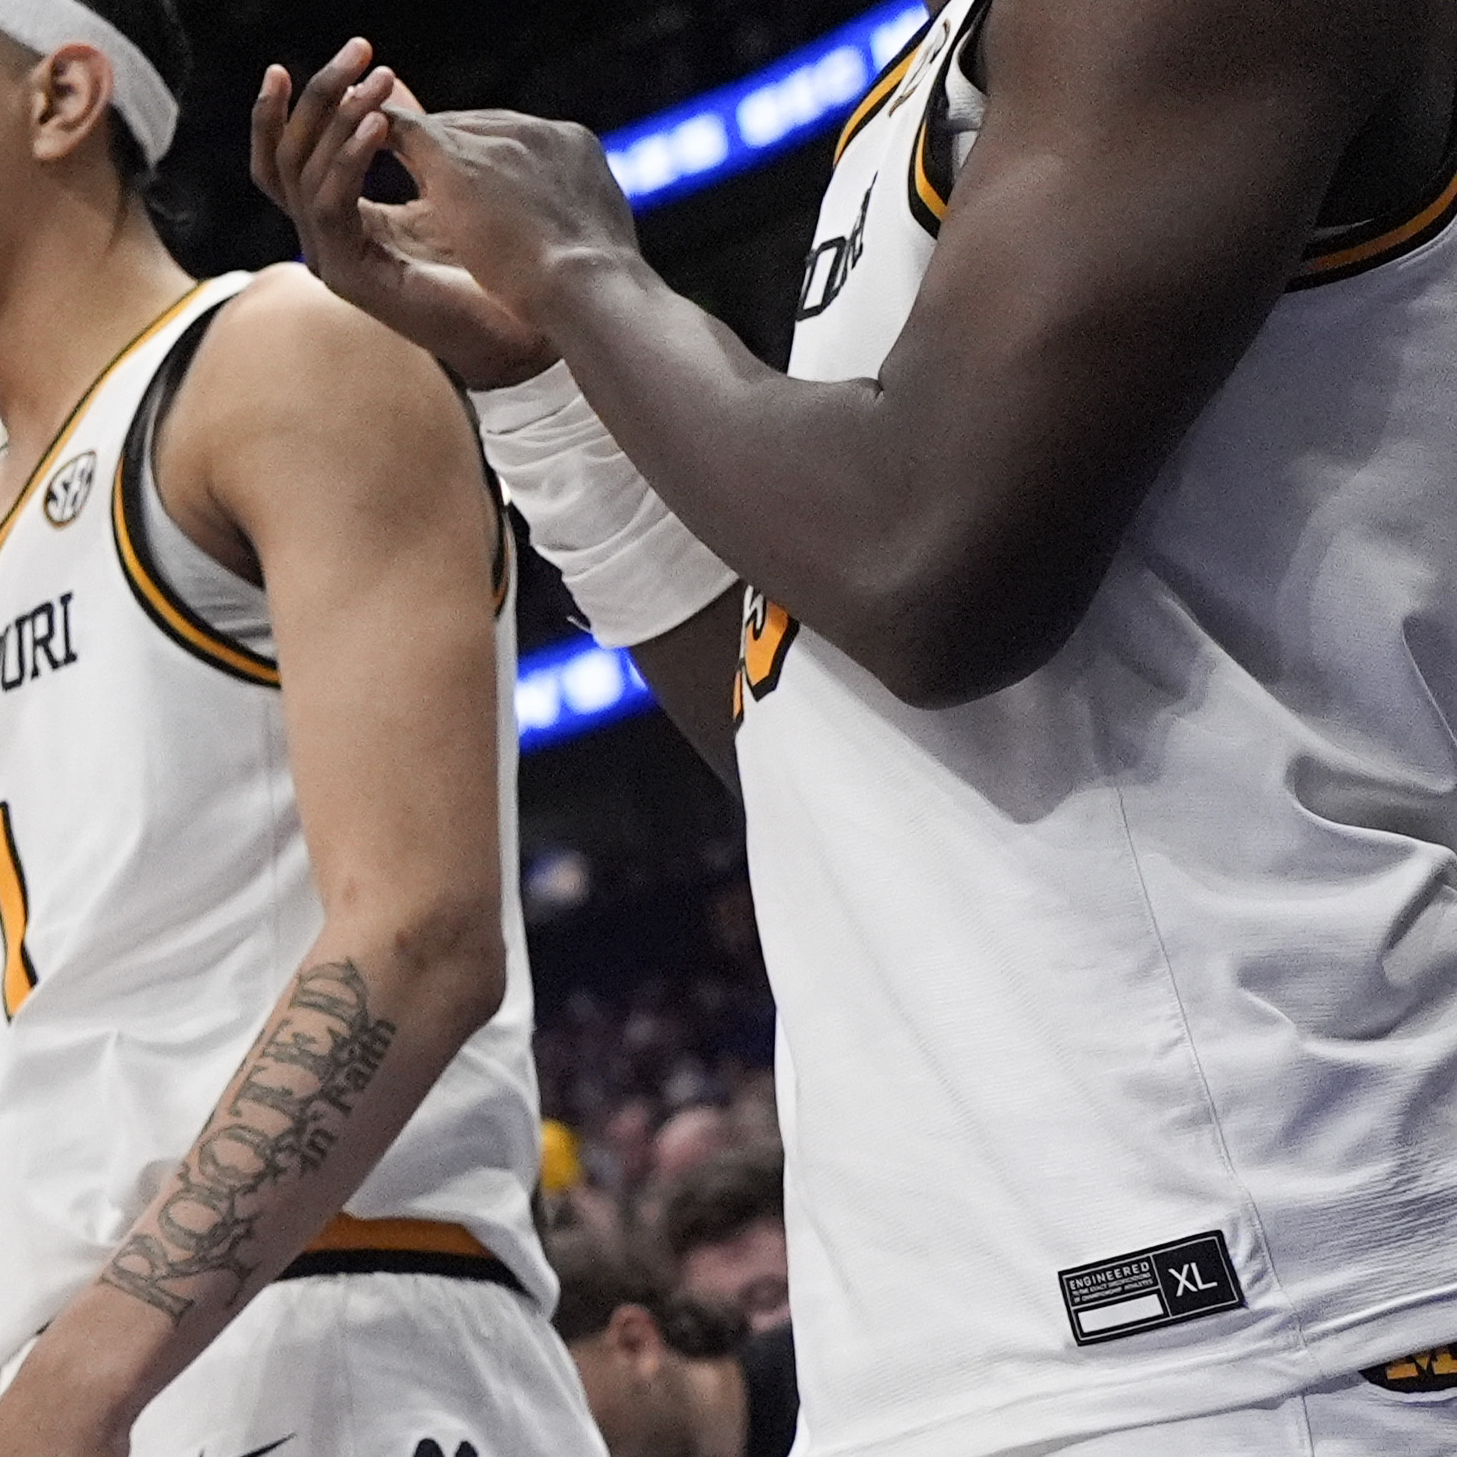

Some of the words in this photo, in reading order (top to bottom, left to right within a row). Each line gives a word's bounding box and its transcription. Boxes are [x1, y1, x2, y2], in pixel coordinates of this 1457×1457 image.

[97, 955, 372, 1328] ROOTED
[1069, 1260, 1151, 1291] ENGINEERED
[1167, 1261, 1219, 1298] XL
